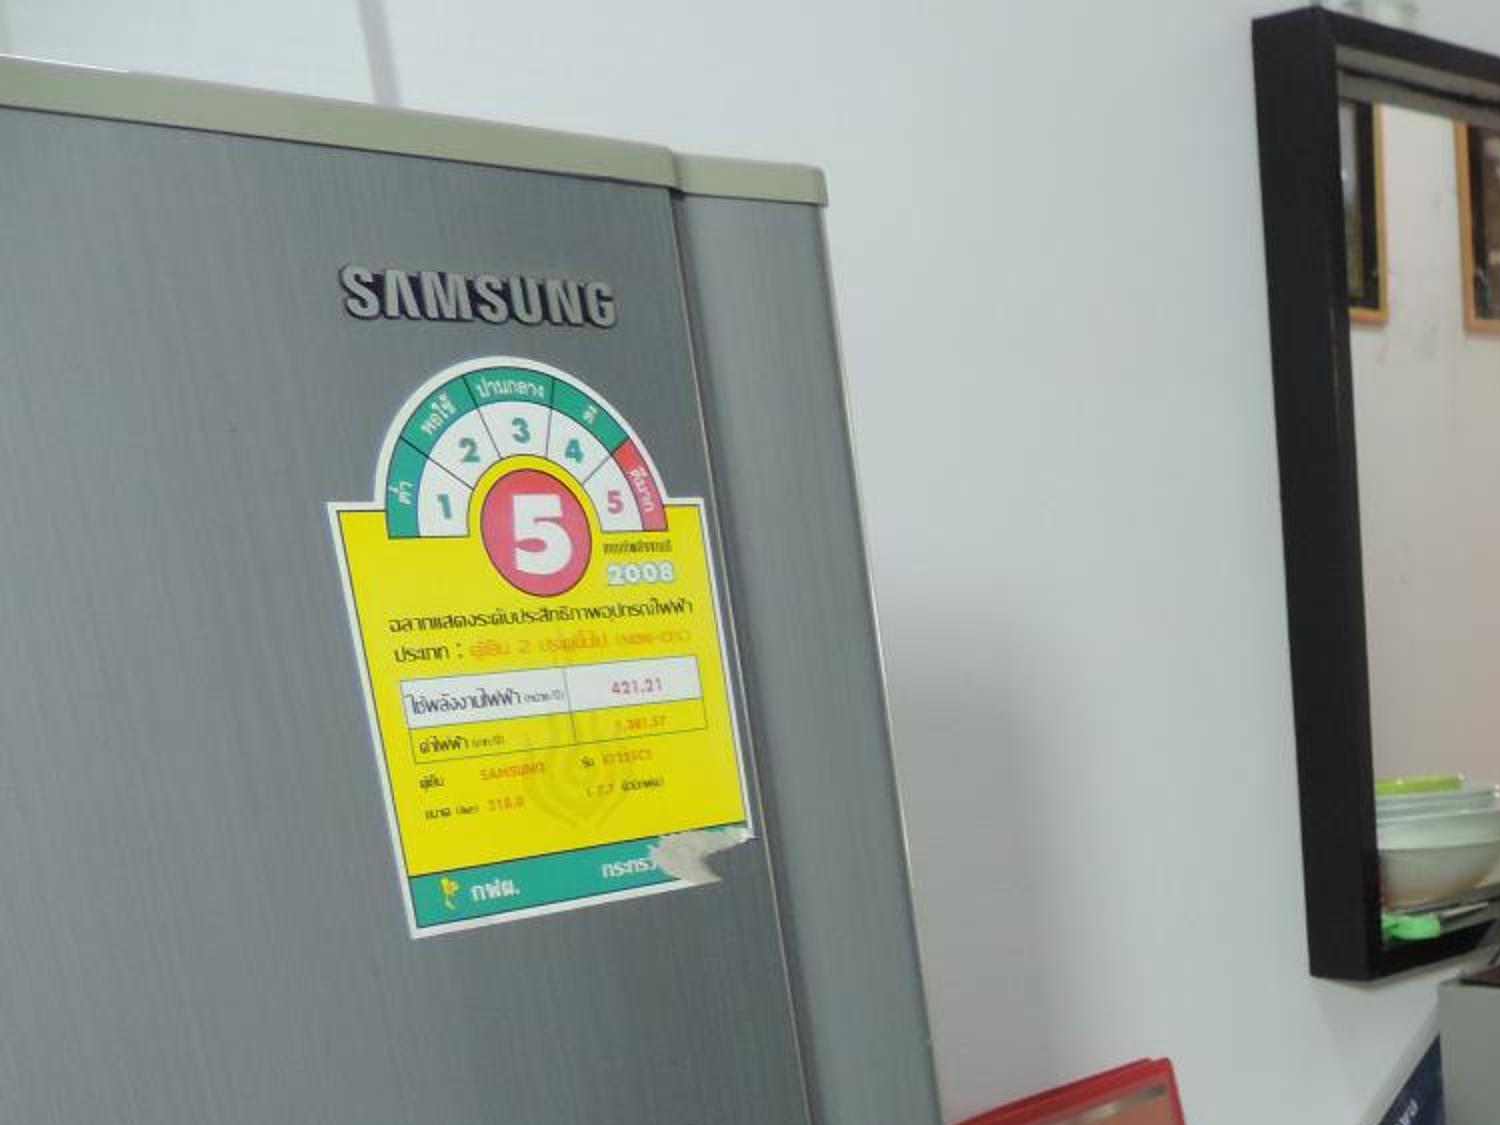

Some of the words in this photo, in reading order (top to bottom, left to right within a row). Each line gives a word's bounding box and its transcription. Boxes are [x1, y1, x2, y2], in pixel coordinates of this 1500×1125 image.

[340, 266, 618, 328] SAMSUNG
[512, 417, 531, 444] 3
[459, 437, 481, 463] 2
[565, 438, 584, 464] 4
[437, 493, 452, 519] 1
[607, 489, 625, 514] 5
[511, 493, 573, 576] 5
[611, 677, 663, 694] 421.21
